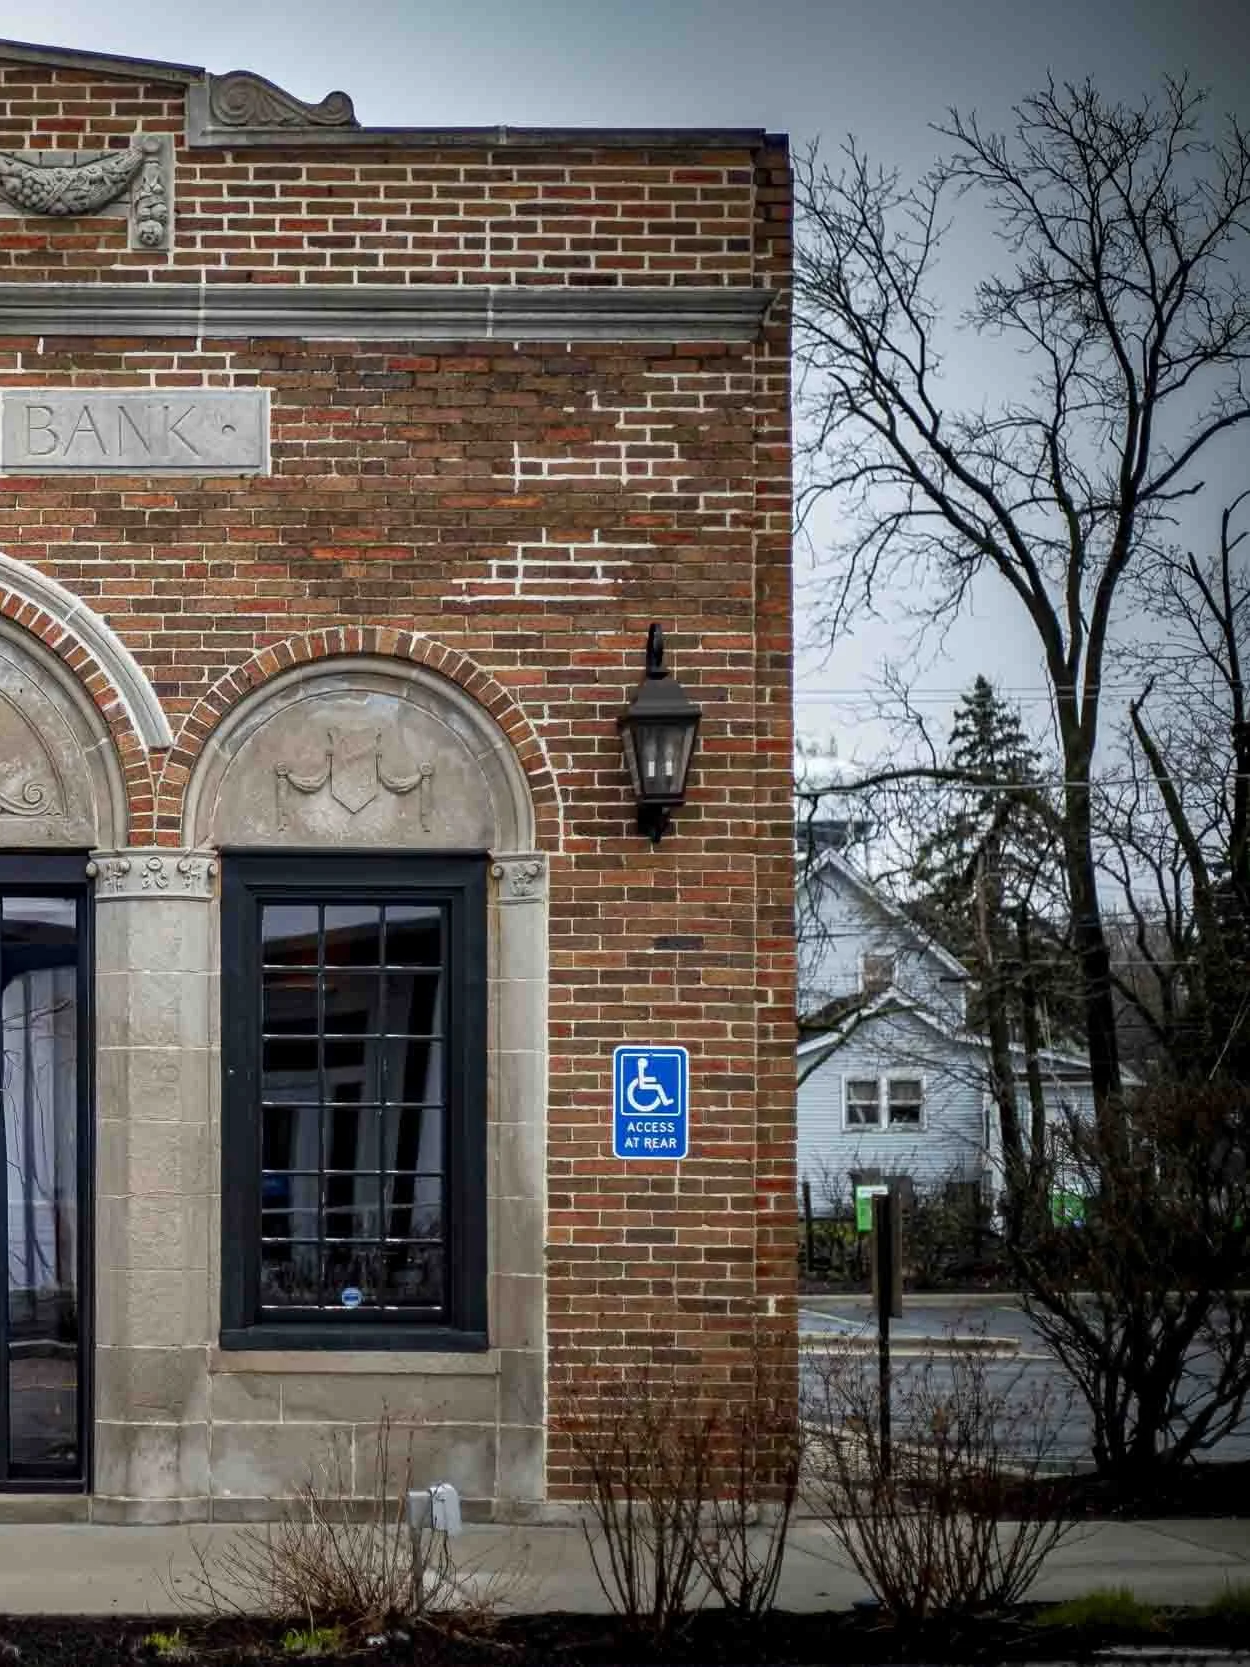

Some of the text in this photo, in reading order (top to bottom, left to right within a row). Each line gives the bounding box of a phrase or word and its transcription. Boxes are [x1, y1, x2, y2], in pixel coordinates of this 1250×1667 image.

[25, 404, 200, 456] BANK
[627, 1121, 675, 1133] ACCESS
[624, 1137, 677, 1149] AT REAR
